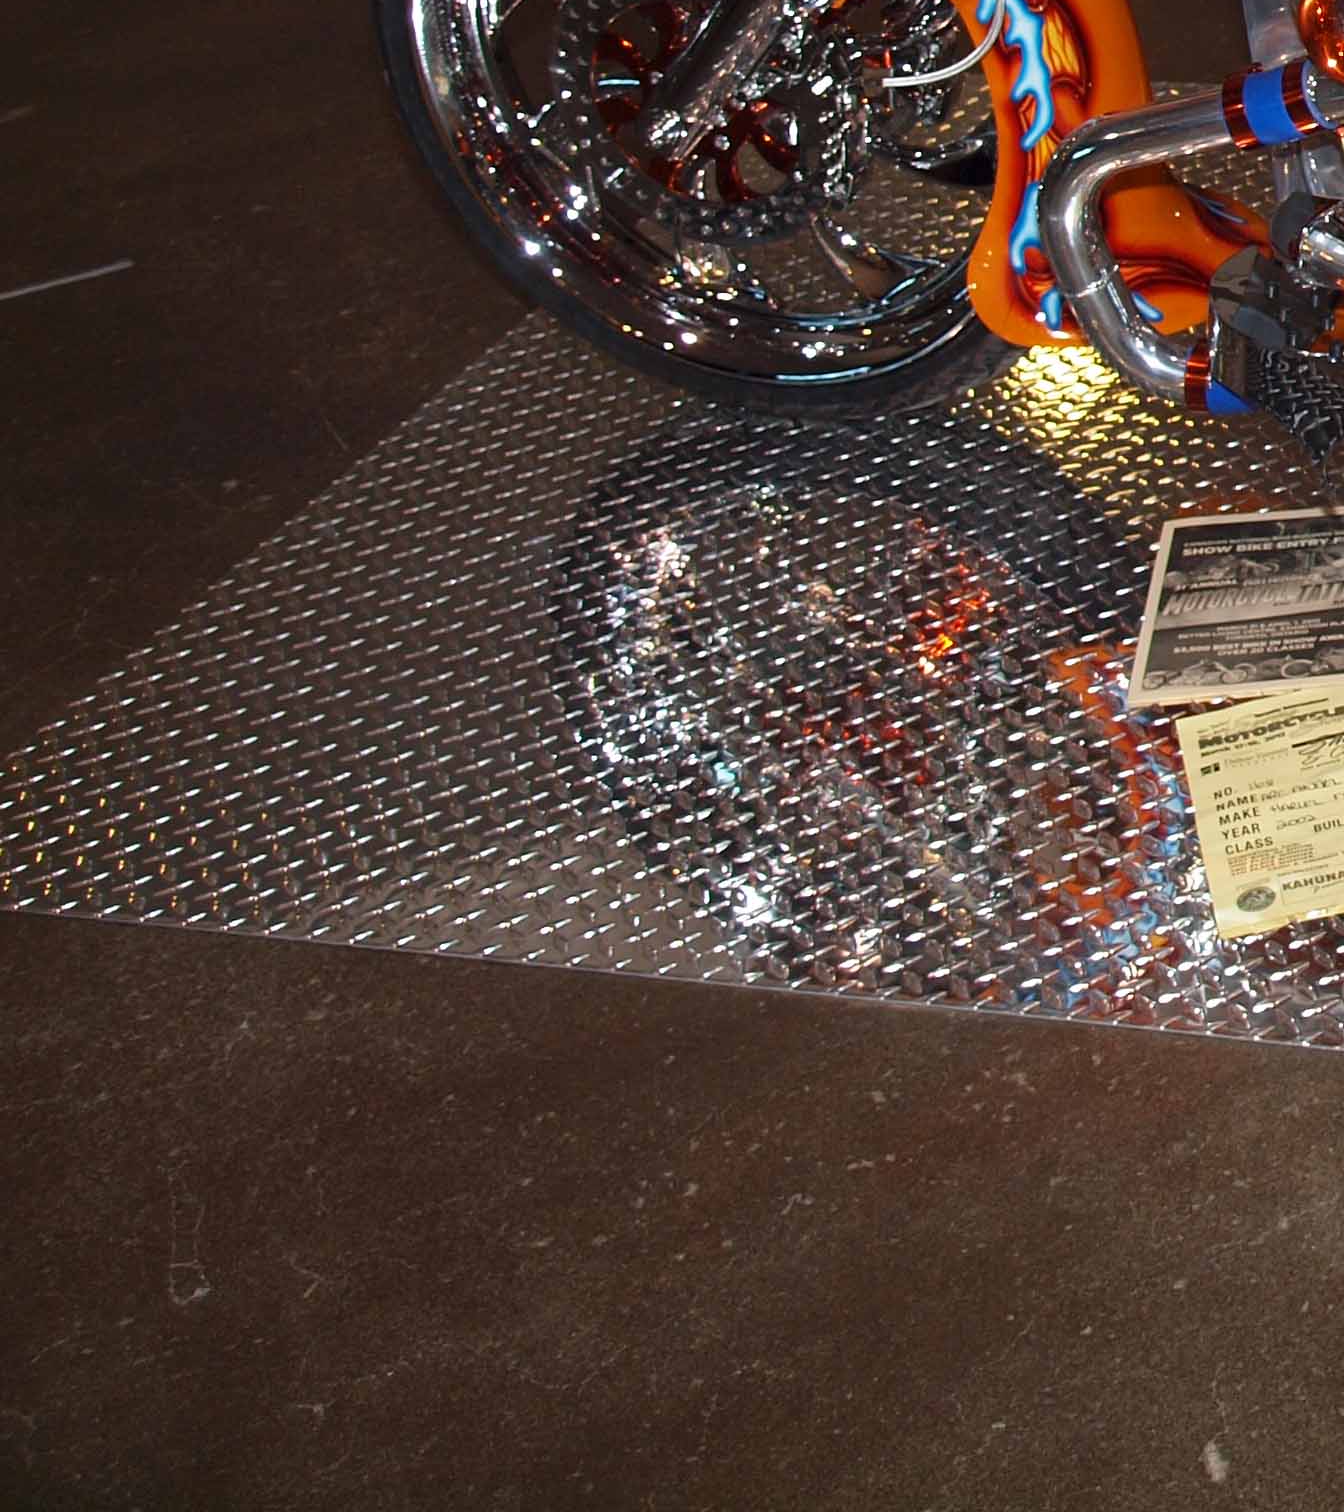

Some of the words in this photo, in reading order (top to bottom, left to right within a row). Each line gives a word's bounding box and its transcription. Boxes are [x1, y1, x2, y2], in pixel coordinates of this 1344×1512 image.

[1182, 545, 1233, 557] SHOW
[1236, 542, 1273, 553] BIKE
[1275, 538, 1329, 550] ENTRY
[1215, 794, 1259, 813] NAME
[1217, 807, 1262, 826] MAKE
[1221, 823, 1261, 841] YEAR
[1224, 836, 1274, 856] CLASS
